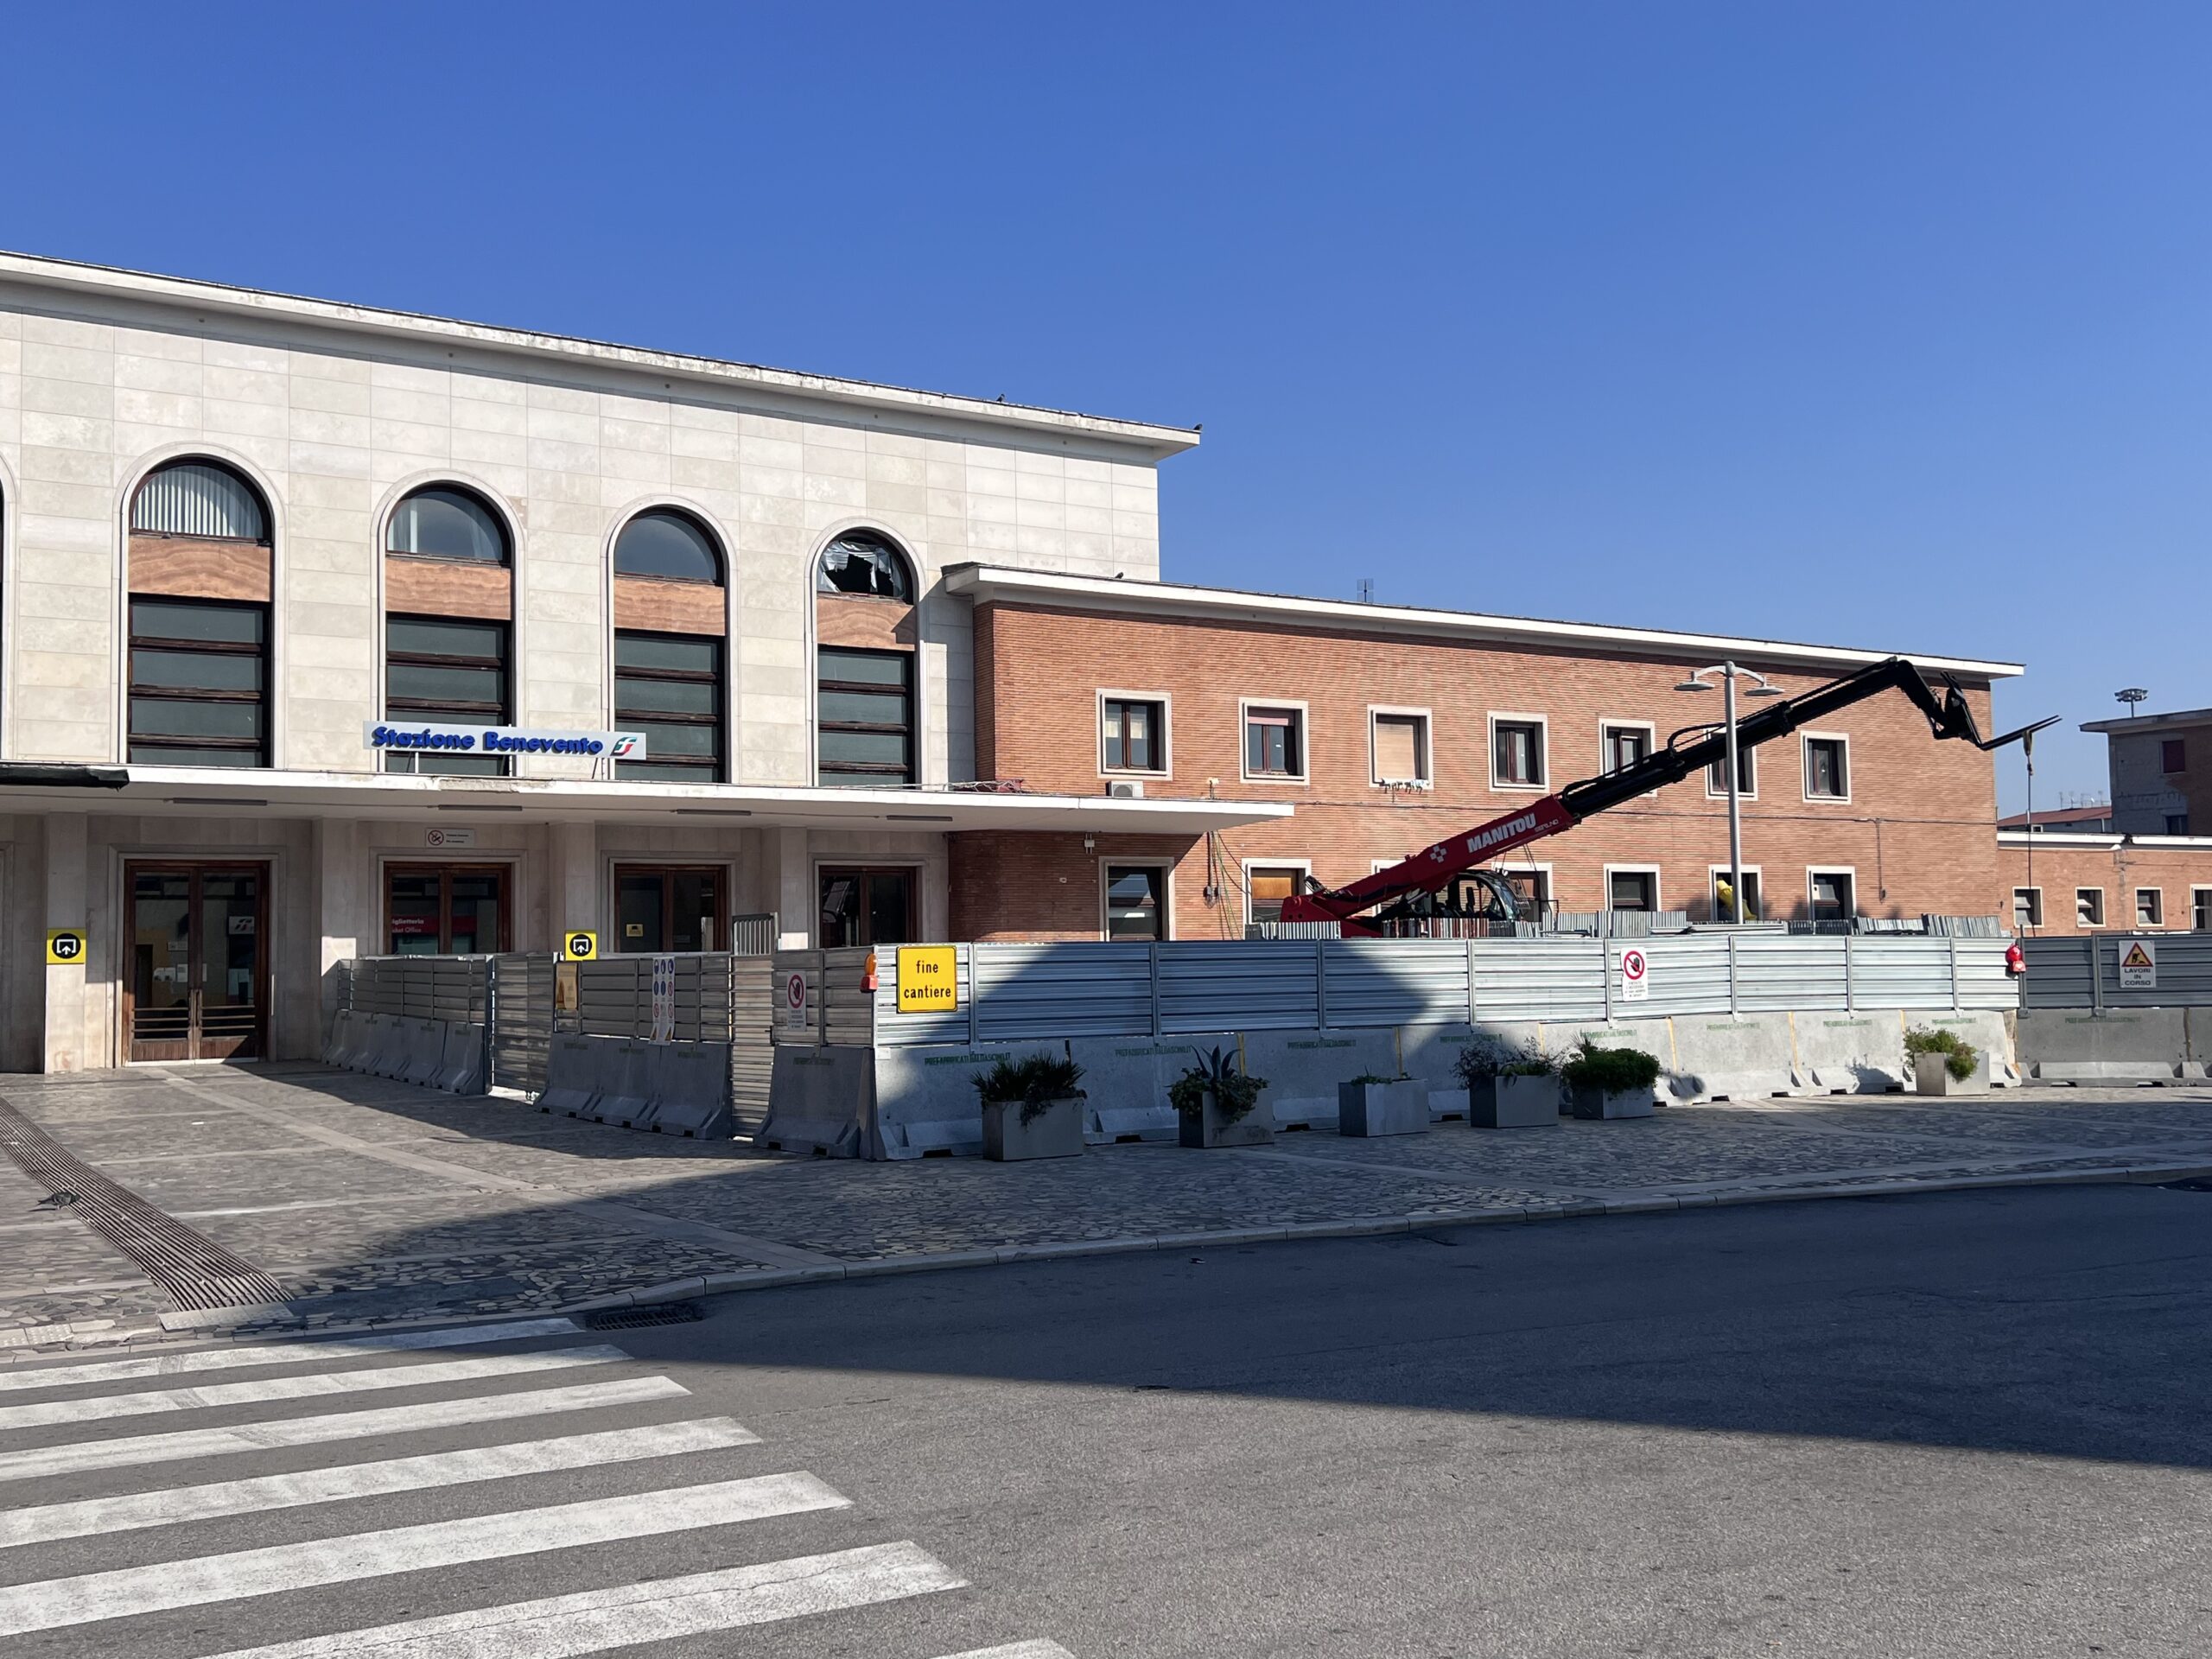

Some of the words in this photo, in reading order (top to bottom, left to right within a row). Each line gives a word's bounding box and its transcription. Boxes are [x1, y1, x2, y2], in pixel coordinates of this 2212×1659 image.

[372, 726, 475, 750] Stazione
[482, 731, 604, 754] Benevento
[1466, 812, 1536, 854] MANITOU
[916, 960, 938, 974] fine
[904, 984, 951, 999] cantiere
